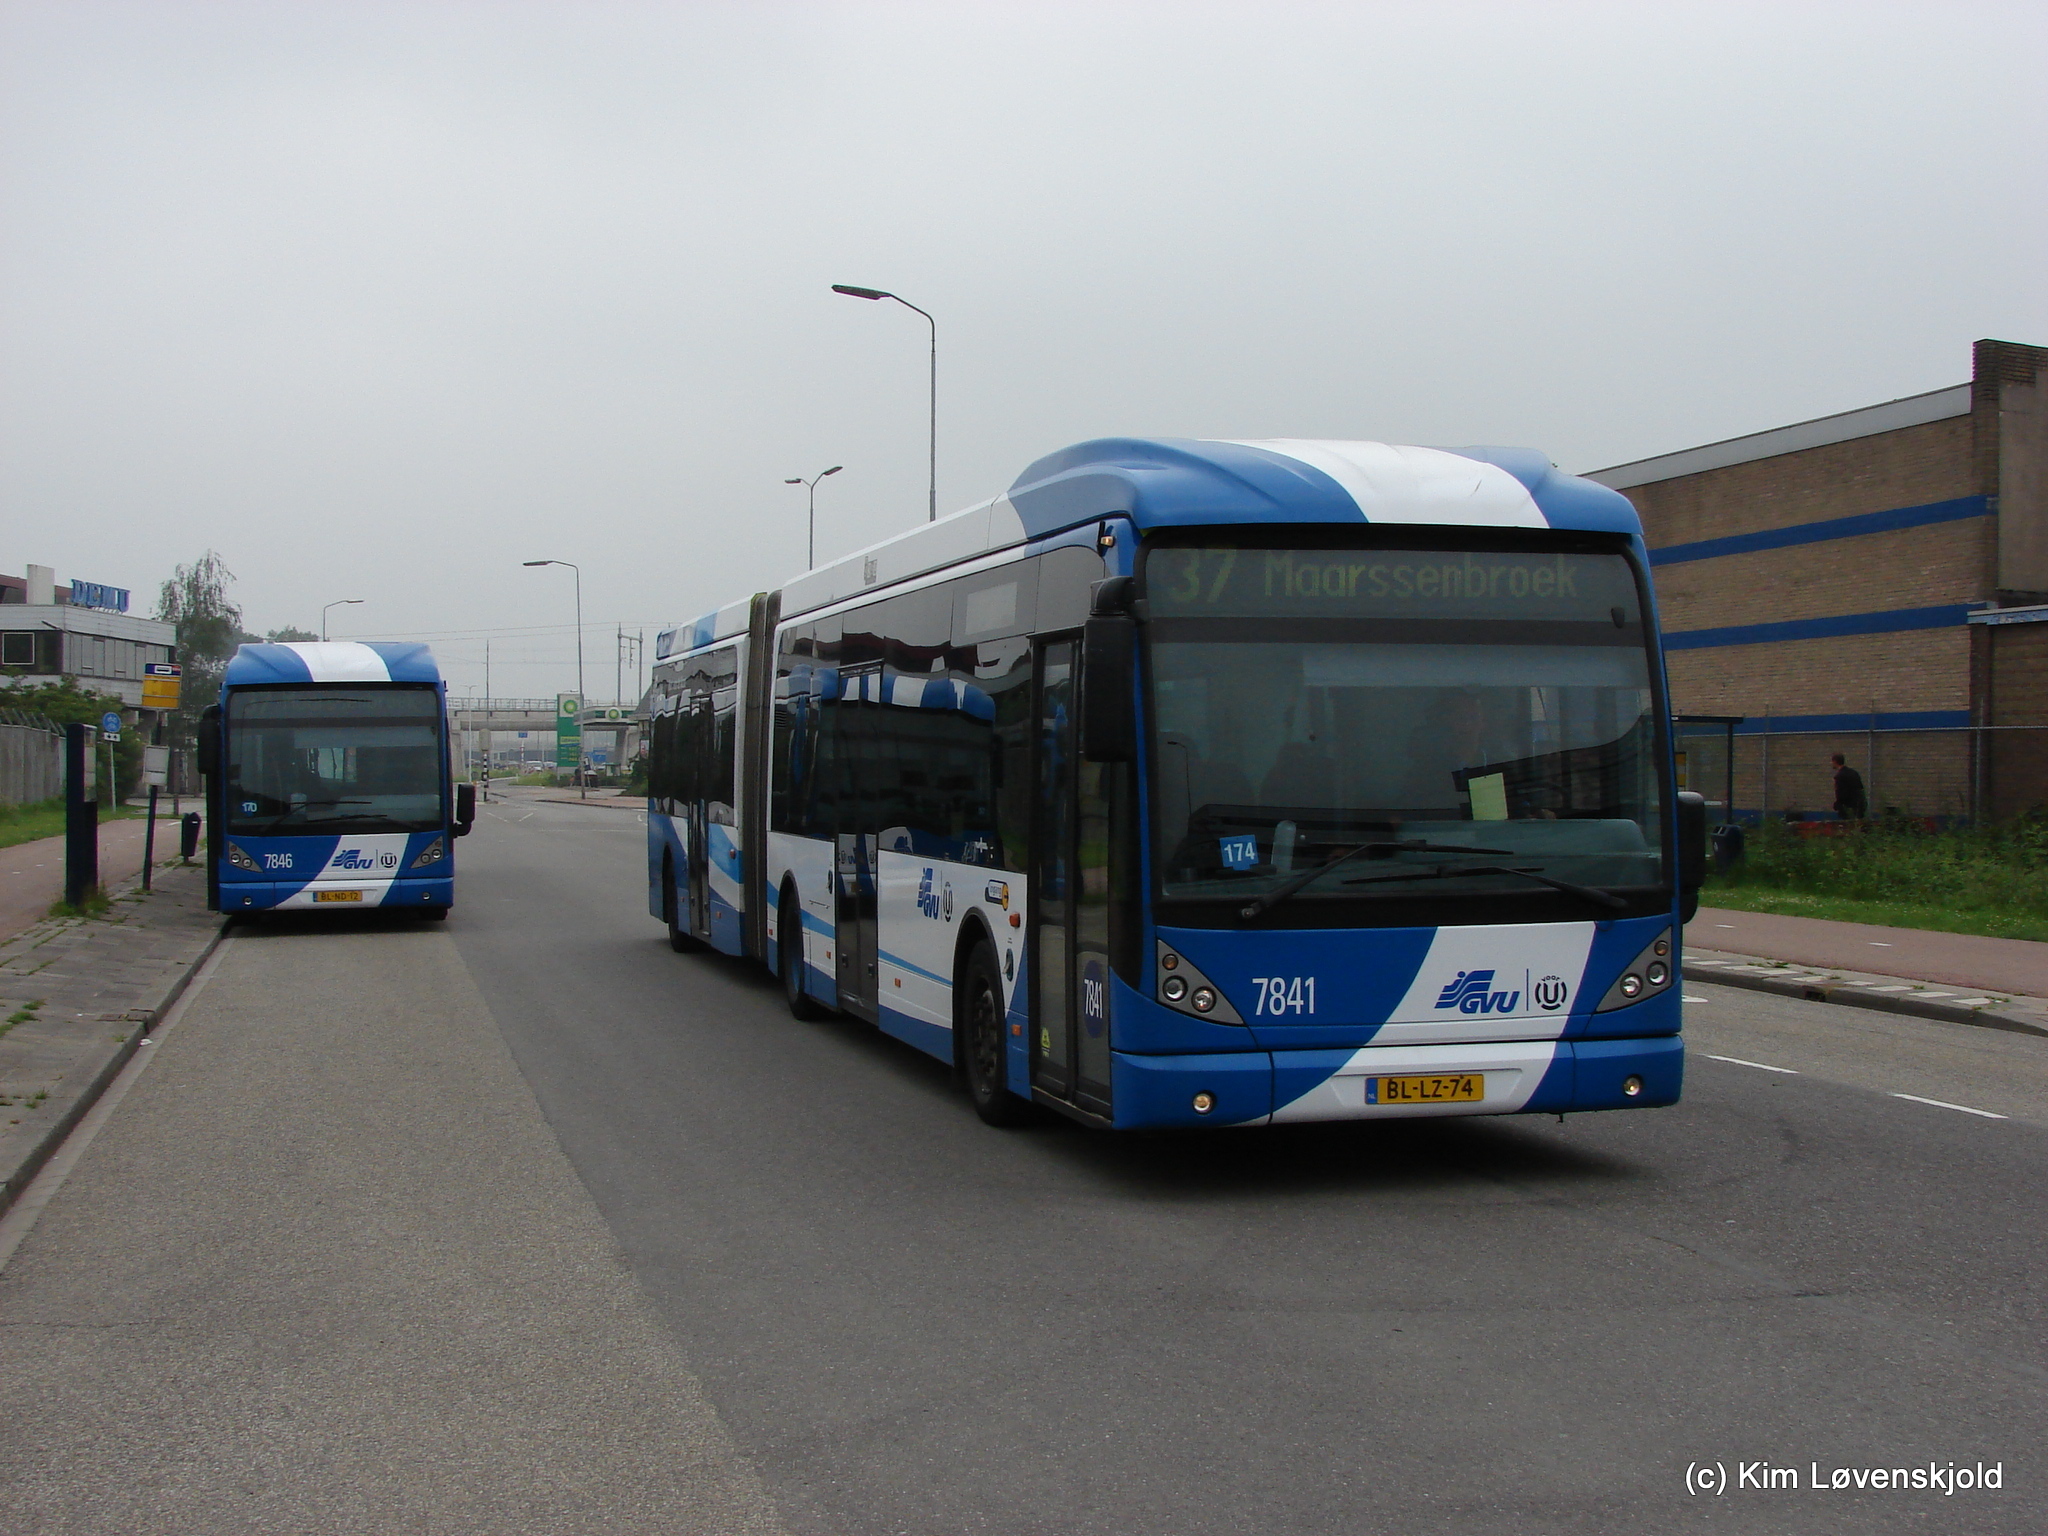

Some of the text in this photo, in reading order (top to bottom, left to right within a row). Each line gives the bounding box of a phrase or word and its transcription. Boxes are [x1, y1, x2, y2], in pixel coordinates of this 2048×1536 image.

[1167, 546, 1577, 603] 37 Maarssenbroek
[242, 802, 258, 812] 170
[265, 853, 293, 869] 7846
[1224, 842, 1255, 862] 174
[343, 859, 373, 870] GVU
[321, 892, 359, 901] BL-ND-12
[1084, 979, 1102, 1018] 7841
[1252, 977, 1316, 1016] 7841
[1459, 991, 1520, 1014] GVU
[1386, 1078, 1473, 1100] BL-LZ-74
